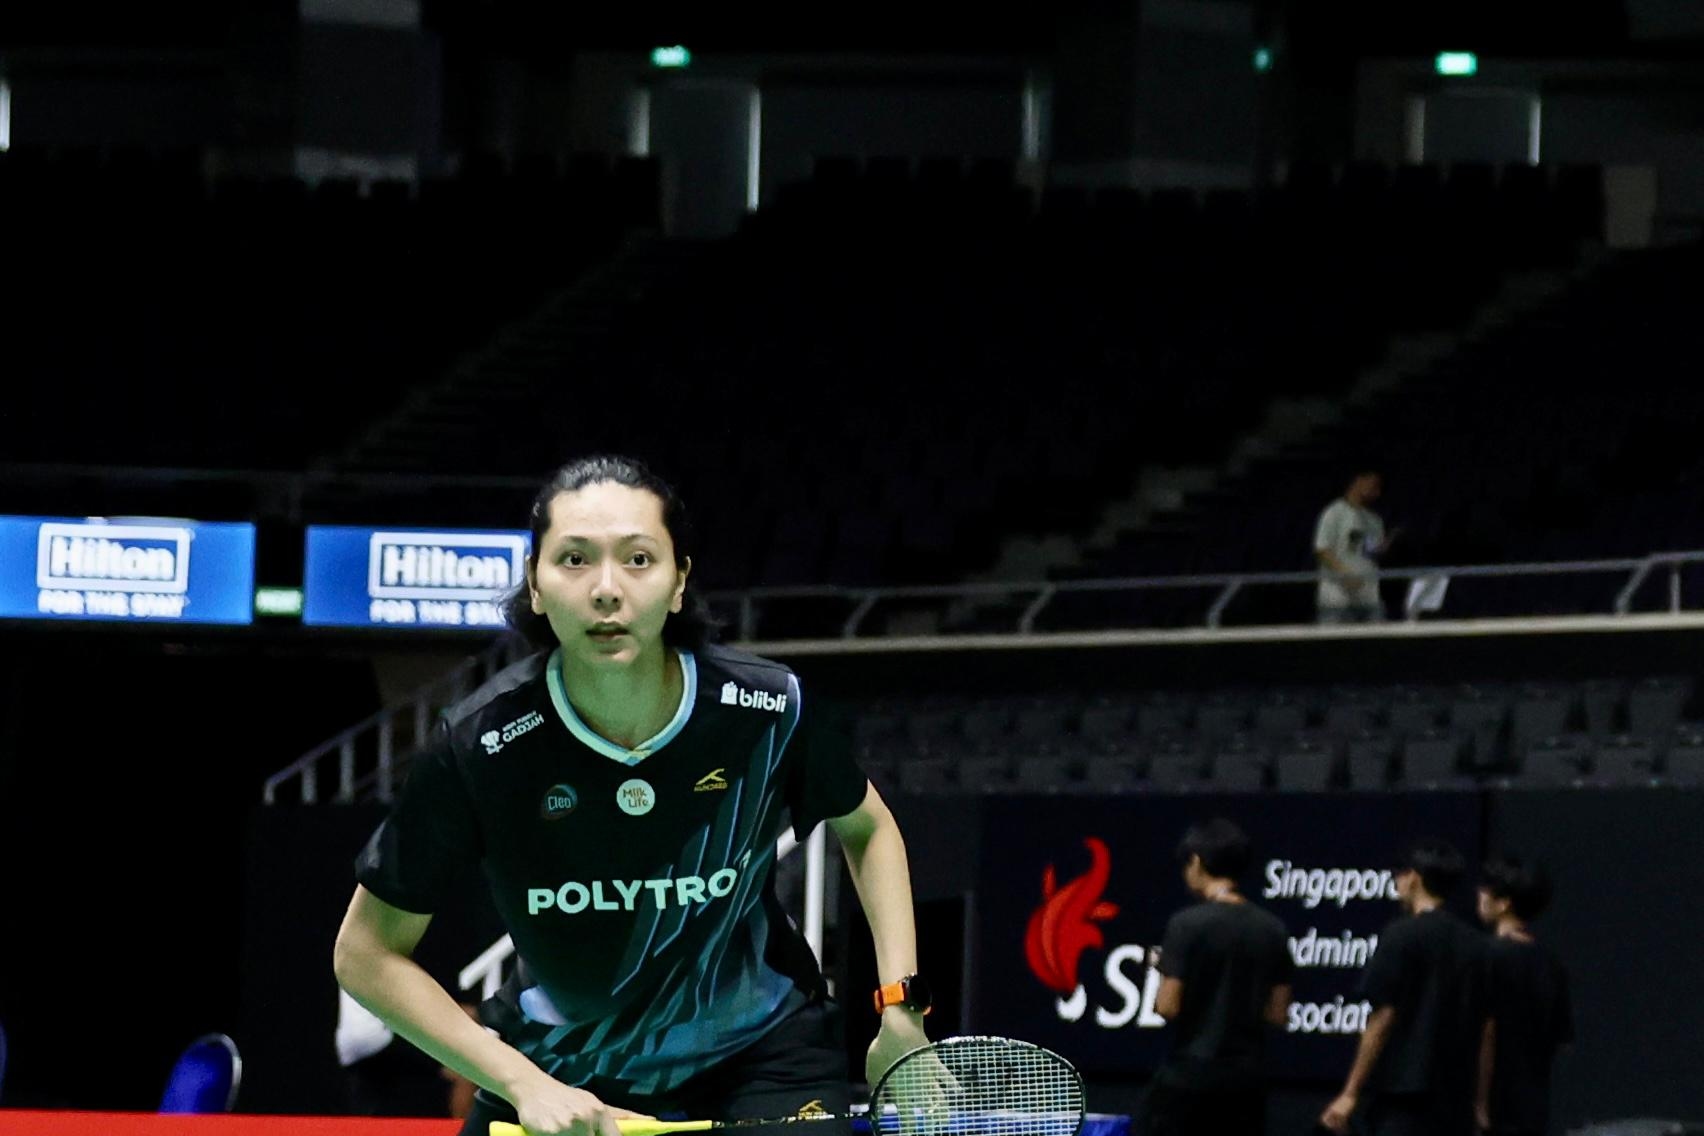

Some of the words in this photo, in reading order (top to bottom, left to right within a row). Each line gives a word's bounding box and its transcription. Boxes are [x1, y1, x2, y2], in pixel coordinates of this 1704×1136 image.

[51, 535, 175, 580] Hilton
[383, 545, 510, 588] Hilton
[739, 687, 787, 713] blibli
[622, 786, 648, 799] Milk
